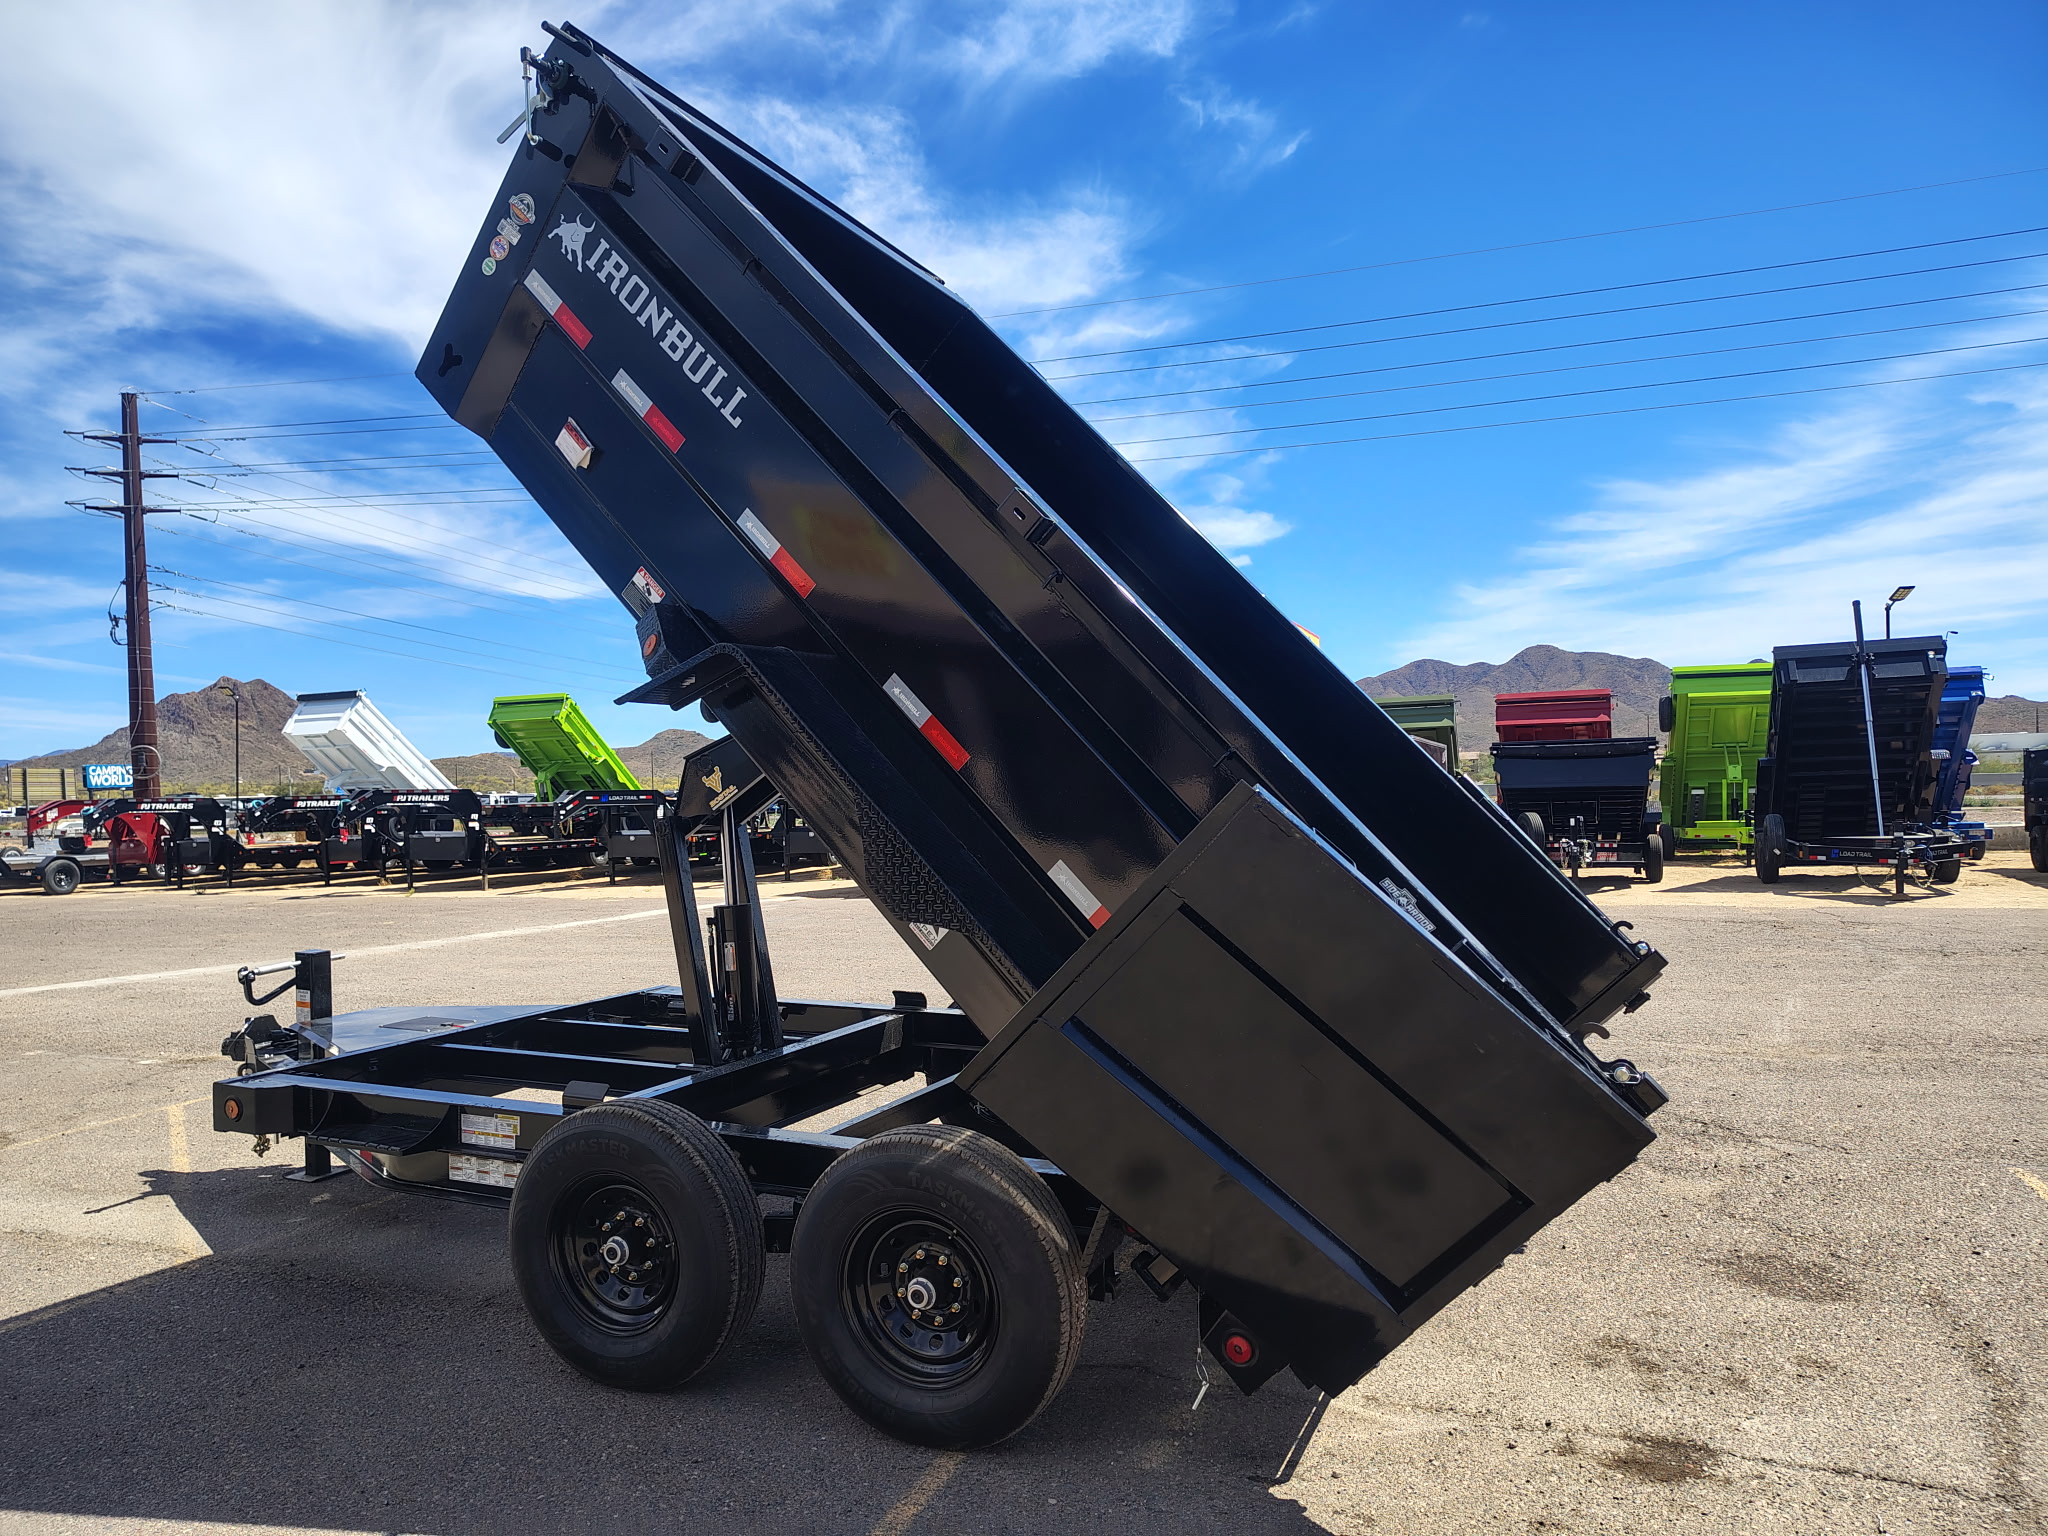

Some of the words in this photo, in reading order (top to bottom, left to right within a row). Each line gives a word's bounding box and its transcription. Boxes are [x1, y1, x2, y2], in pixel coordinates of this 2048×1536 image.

[585, 238, 747, 429] IRONBULL
[644, 572, 663, 596] DANGER
[88, 765, 133, 775] CAMPING
[89, 775, 133, 786] WORLD
[1381, 879, 1401, 898] SIDE
[1406, 903, 1435, 932] ARMOR
[531, 1138, 631, 1179] TASKMASTER
